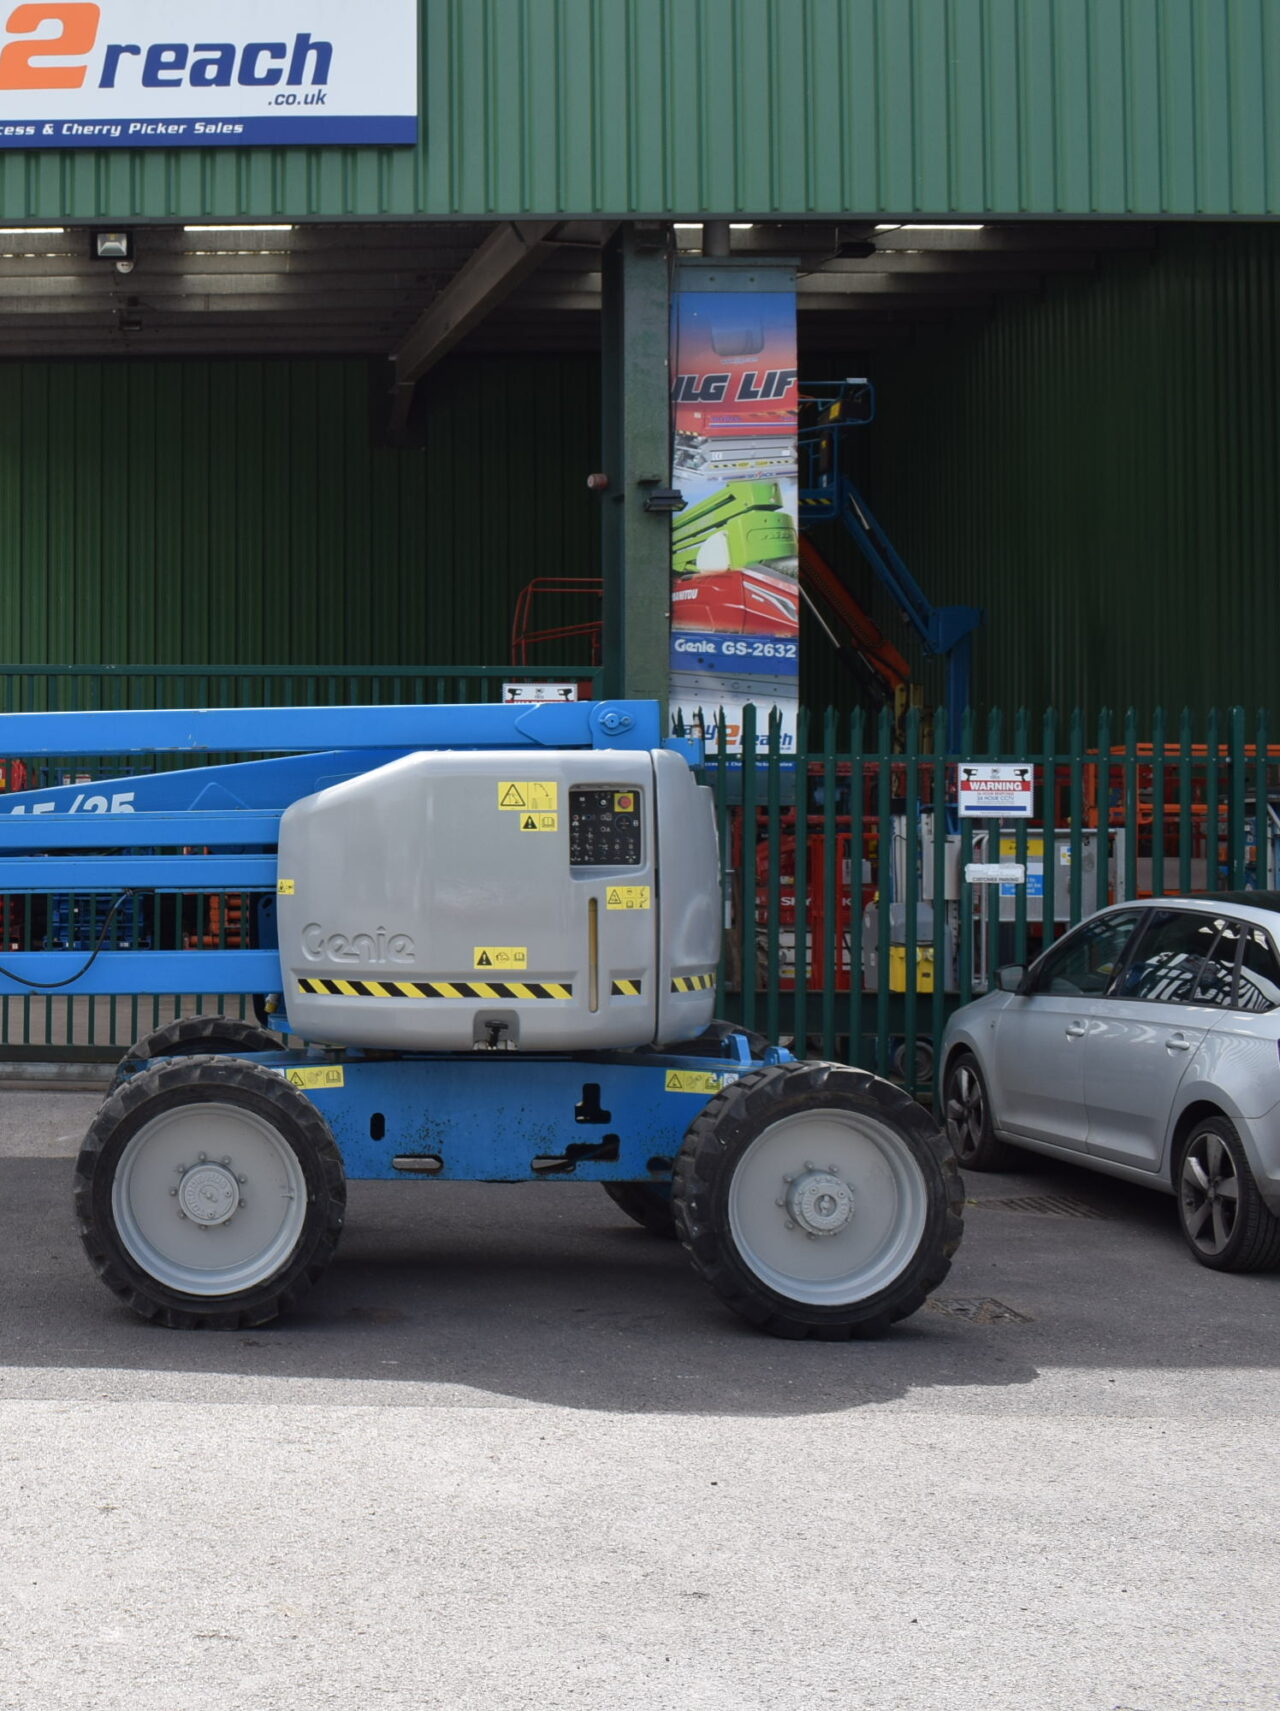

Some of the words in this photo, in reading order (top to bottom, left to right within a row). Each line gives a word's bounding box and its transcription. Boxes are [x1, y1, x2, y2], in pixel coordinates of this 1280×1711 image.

[268, 89, 327, 106] .co.uk
[42, 123, 54, 135] &
[62, 122, 121, 137] Cherry
[128, 122, 187, 134] Picker
[194, 121, 244, 134] Sales
[674, 639, 716, 653] Genie
[722, 641, 797, 658] GS-2632
[970, 781, 1022, 791] WARNING
[302, 922, 416, 963] Genie
